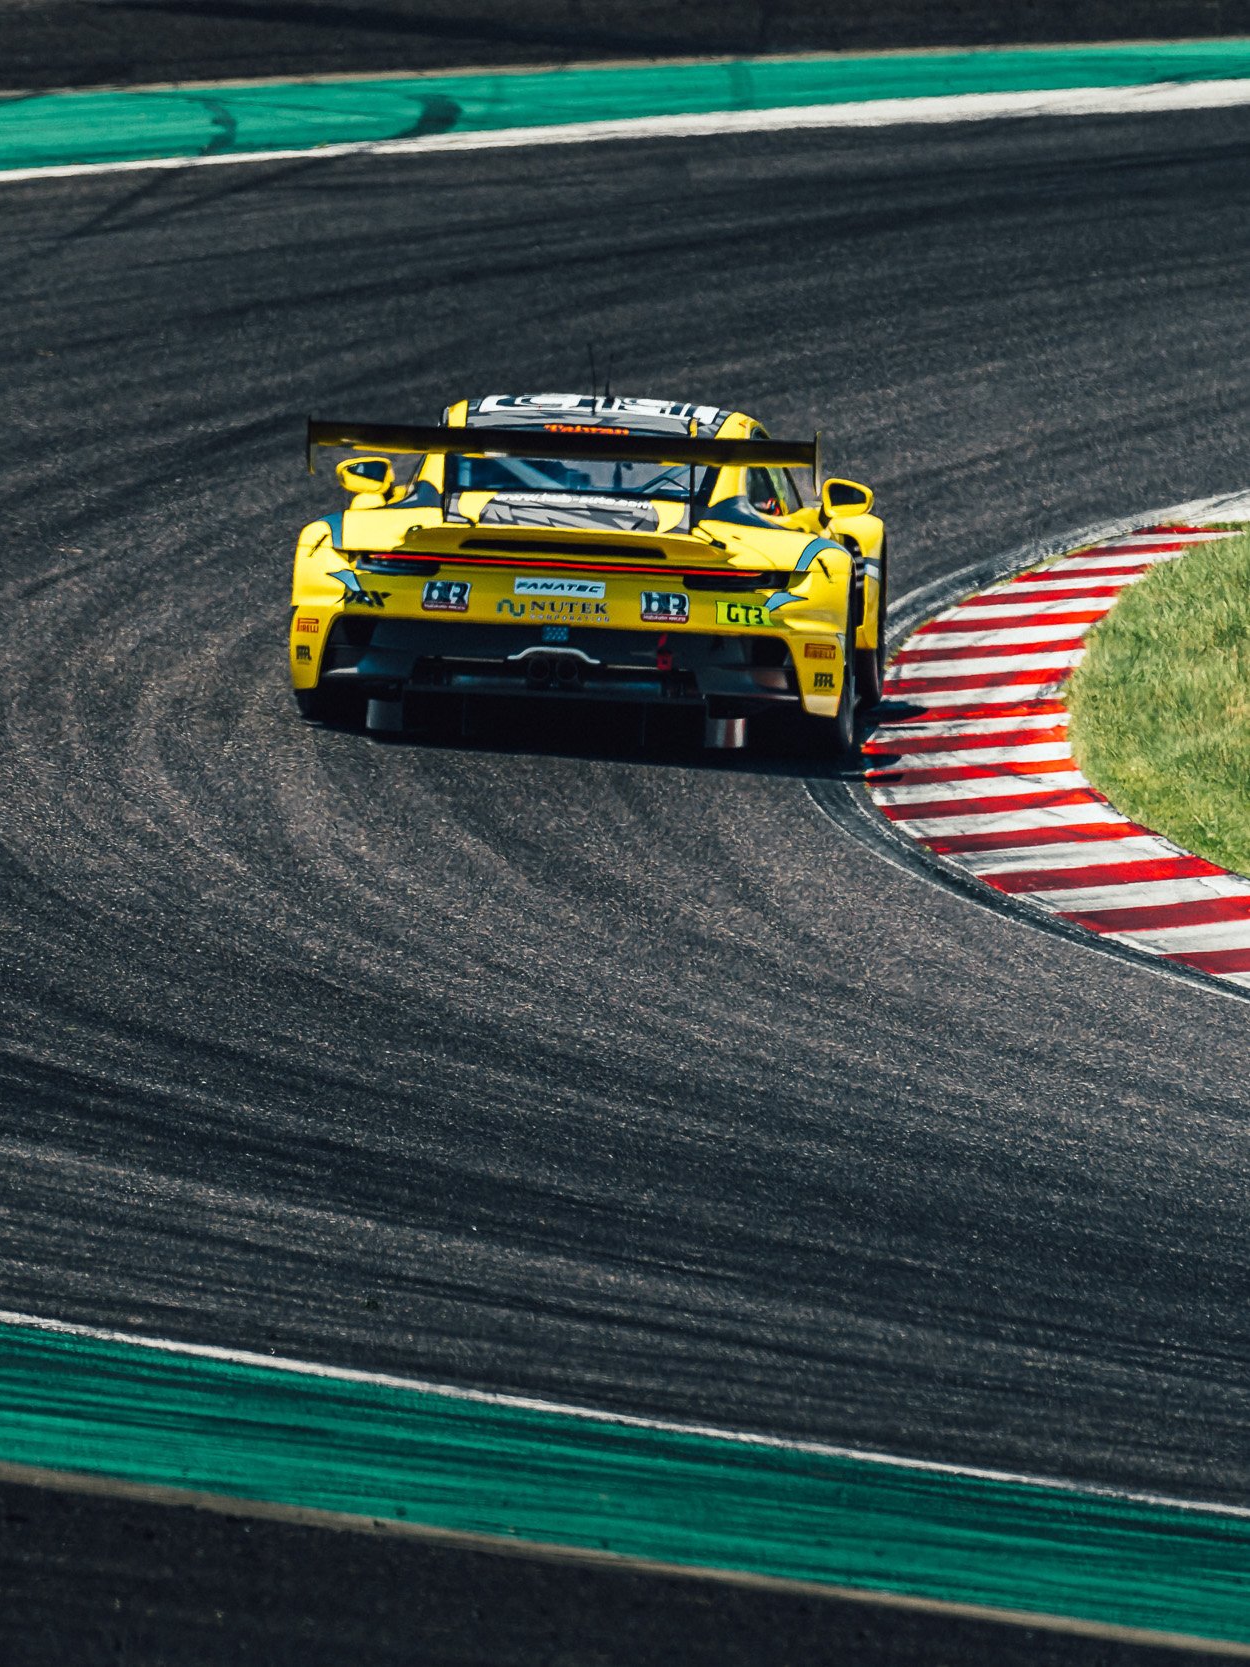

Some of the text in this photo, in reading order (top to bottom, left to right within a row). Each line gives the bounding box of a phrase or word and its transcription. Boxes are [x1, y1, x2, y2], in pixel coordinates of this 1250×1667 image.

[515, 581, 603, 594] FANATEC
[530, 600, 609, 615] NUTEK
[726, 603, 765, 626] GT3
[295, 616, 320, 633] PIRELLI
[530, 613, 610, 623] CORPORATION
[803, 642, 837, 661] PIRELLI
